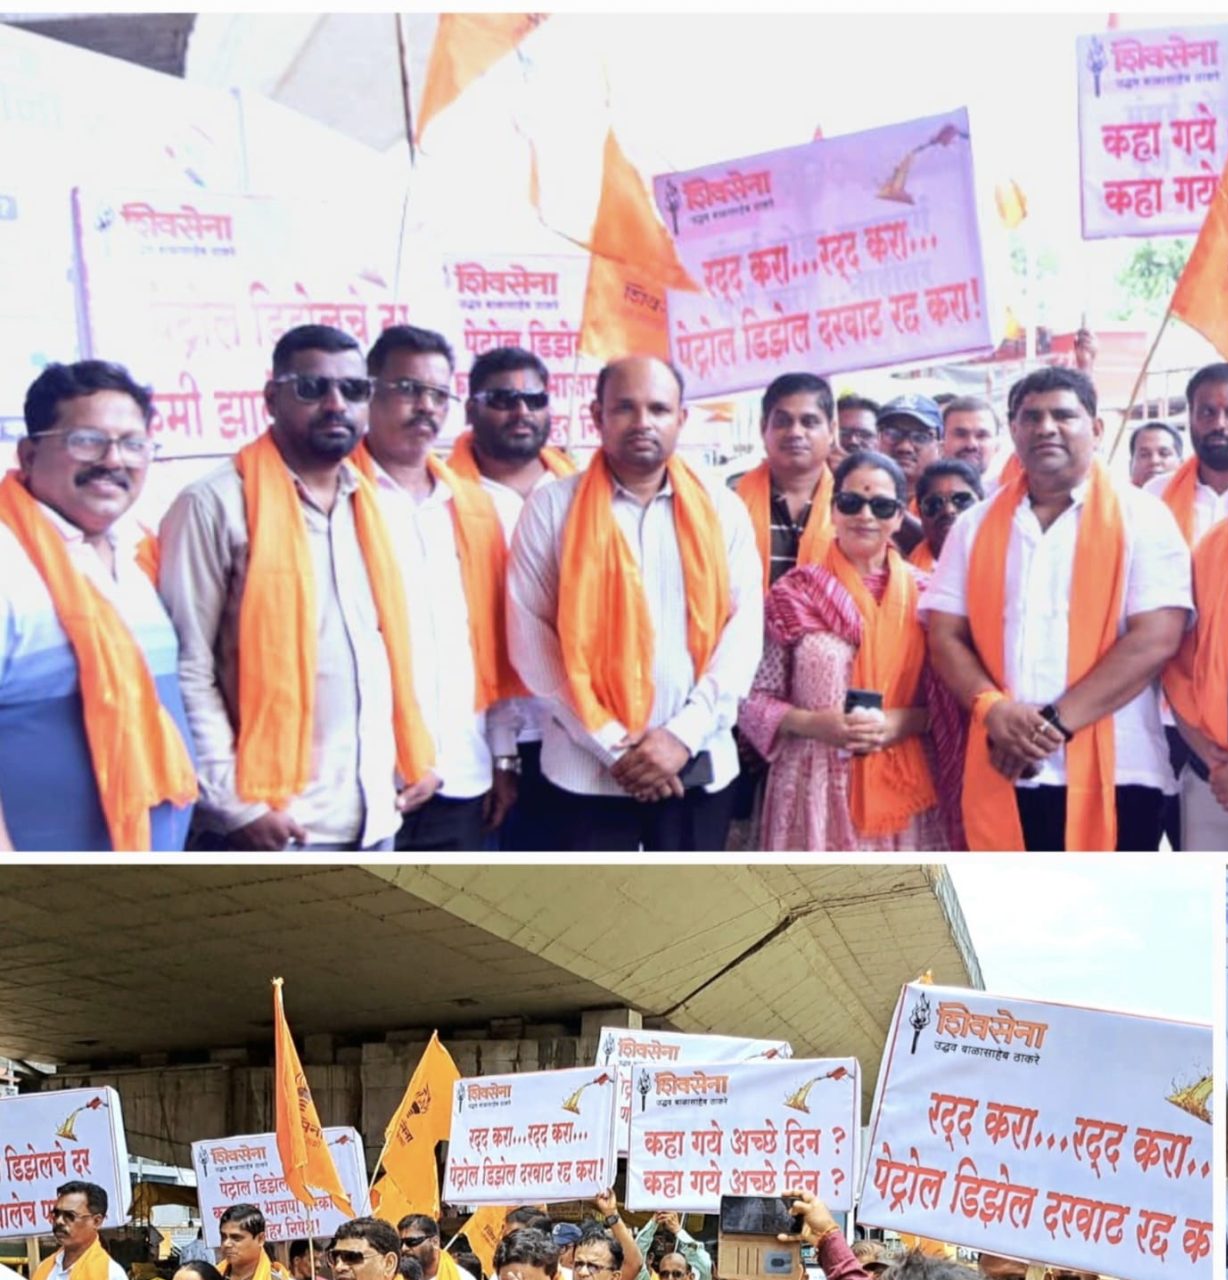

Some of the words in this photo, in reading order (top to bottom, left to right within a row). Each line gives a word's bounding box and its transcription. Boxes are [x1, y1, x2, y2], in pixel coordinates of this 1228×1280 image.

[1111, 33, 1218, 73] शिवसेना
[1101, 122, 1161, 162] कहा
[1170, 102, 1216, 155] गये
[682, 169, 772, 210] शिवसेना
[1103, 178, 1163, 218] कहा
[455, 262, 557, 296] शिवसेना
[676, 319, 736, 380] पेट्रोल
[742, 301, 810, 363] डिझेल
[935, 1001, 1049, 1050] शिवसेना
[618, 1037, 680, 1061] शिवसेना
[934, 1040, 958, 1053] उद्धव
[1012, 1052, 1041, 1066] ठाकरे
[468, 1083, 512, 1101] शिवसेना
[655, 1070, 729, 1096] शिवसेना
[211, 1145, 266, 1165] शिवसेना
[644, 1130, 685, 1160] कहा
[691, 1119, 723, 1156] गये
[730, 1118, 778, 1156] अच्छे
[785, 1118, 821, 1160] दिन
[5, 1140, 66, 1185] डिझेलचे
[71, 1148, 91, 1177] दर
[450, 1157, 479, 1191] पेट्रोल
[482, 1155, 517, 1190] डिझेल
[643, 1170, 684, 1199] कहा
[690, 1160, 722, 1196] गये
[729, 1159, 777, 1196] अच्छे
[784, 1159, 820, 1197] दिन
[219, 1175, 250, 1200] पेट्रोल
[873, 1142, 947, 1214] पेट्रोल
[950, 1156, 1039, 1229] डिझेल
